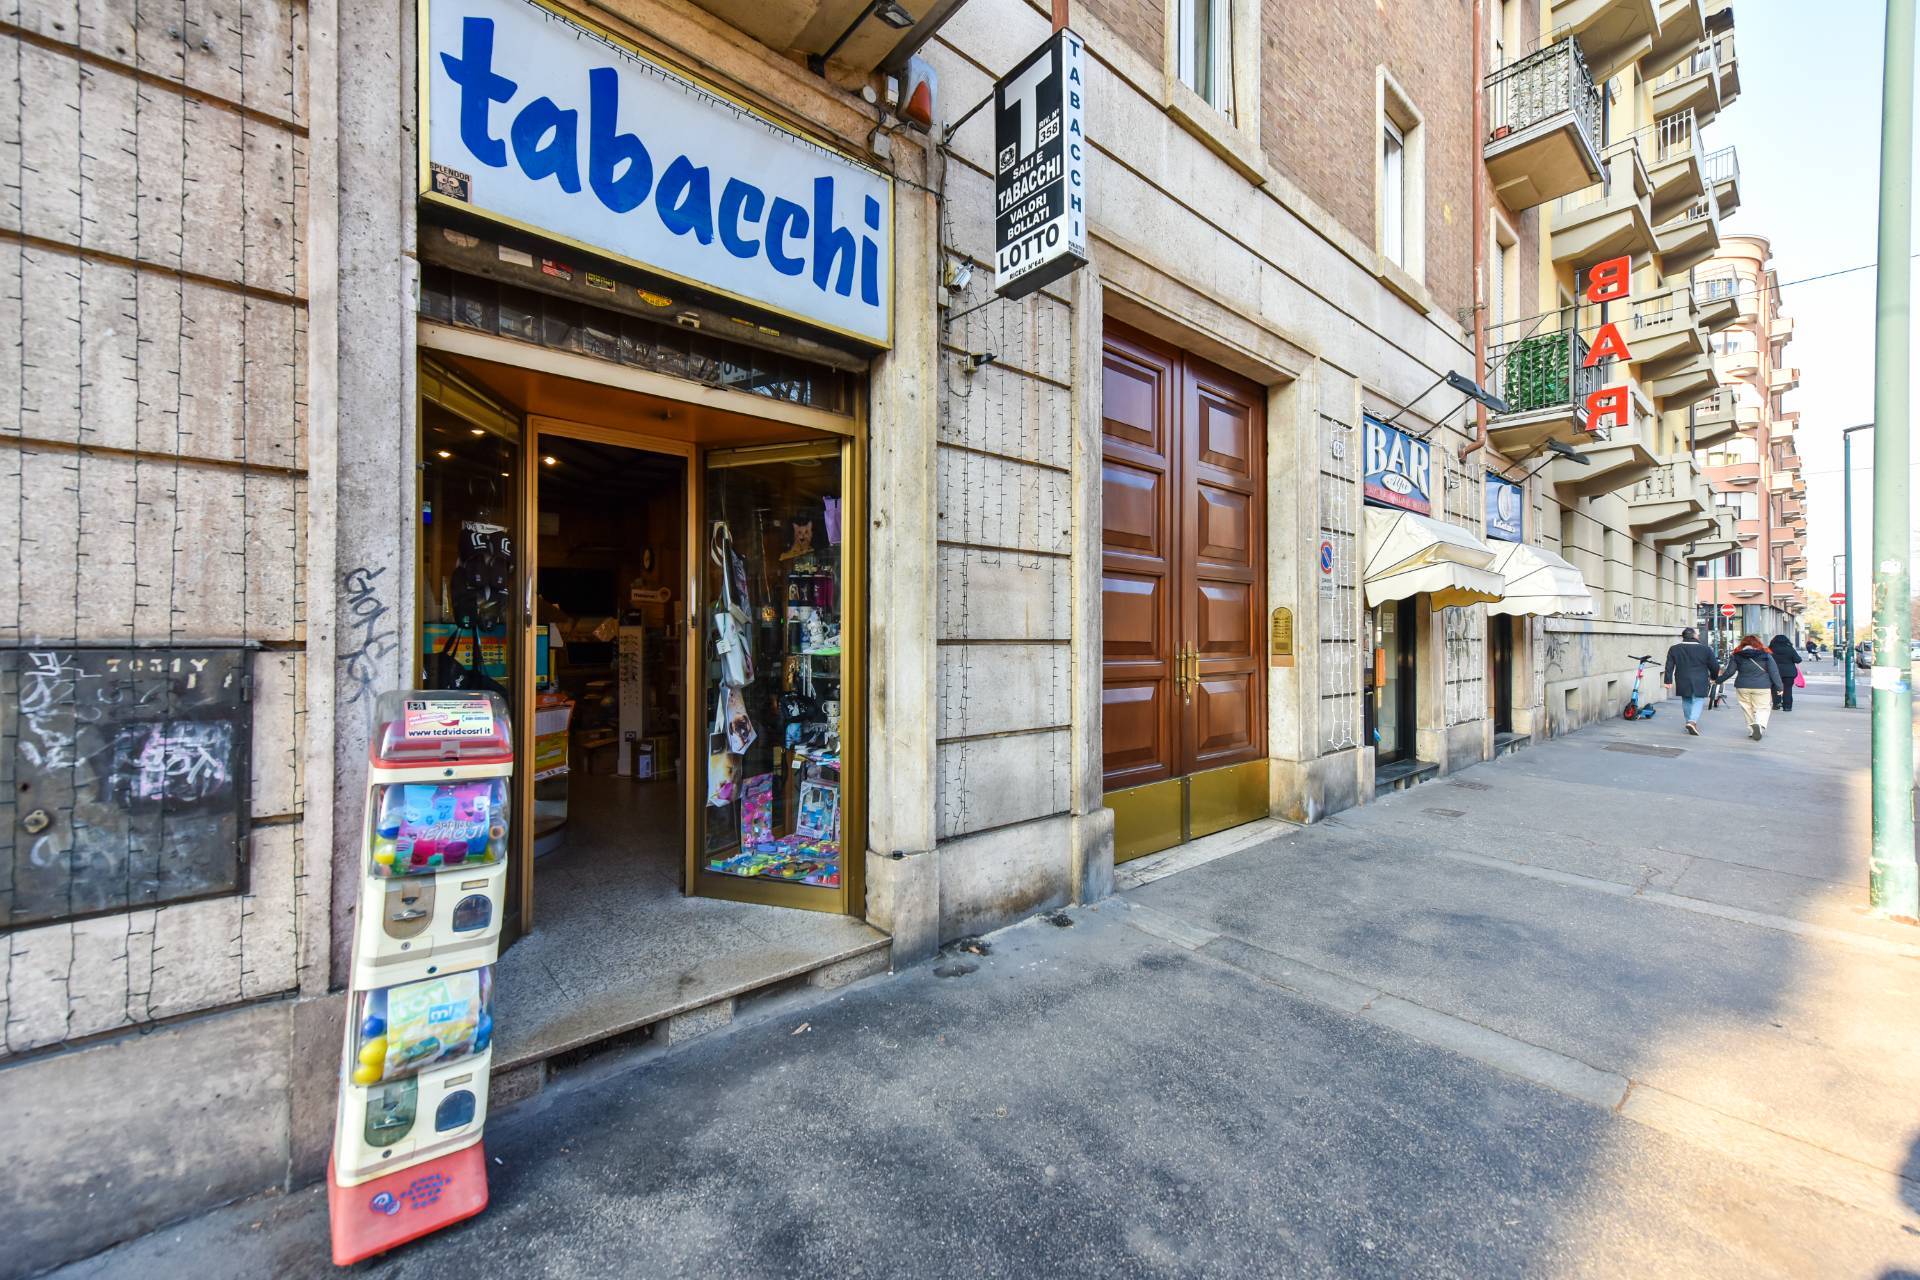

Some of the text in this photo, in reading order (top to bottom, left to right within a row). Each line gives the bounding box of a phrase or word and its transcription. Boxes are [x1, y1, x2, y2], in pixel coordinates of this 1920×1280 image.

[1004, 49, 1053, 161] T
[1040, 121, 1058, 143] 358
[1069, 39, 1082, 237] TABACCHI
[429, 161, 470, 182] SPLENDOR
[440, 16, 880, 307] tabacchi
[998, 154, 1061, 212] TABACCHI
[1013, 152, 1044, 180] SALI E
[1007, 205, 1049, 240] BOLLATI
[1010, 193, 1047, 224] VALORI
[1000, 223, 1059, 274] LOTTO
[1363, 421, 1430, 501] BAR
